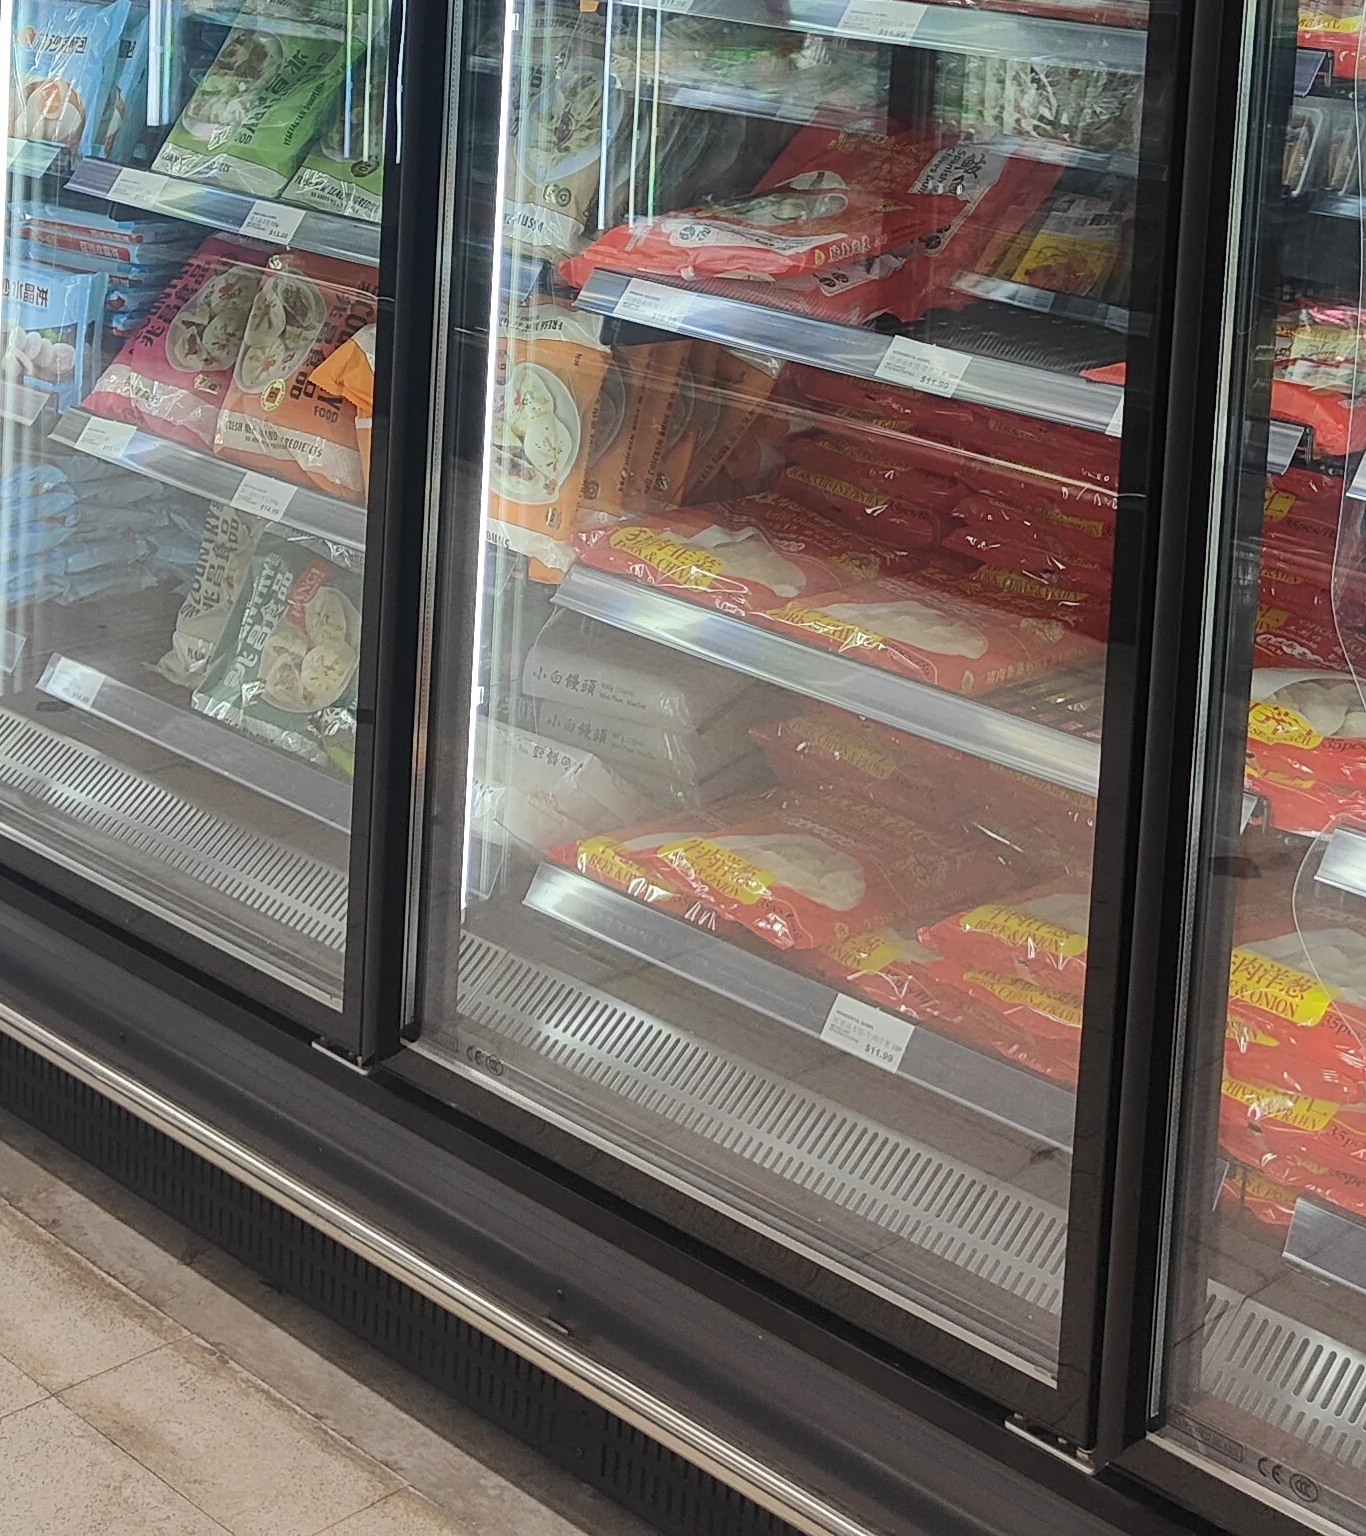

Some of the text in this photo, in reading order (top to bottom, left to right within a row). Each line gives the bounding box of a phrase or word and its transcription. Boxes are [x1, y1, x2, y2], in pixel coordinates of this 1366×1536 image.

[313, 404, 339, 423] FOOD
[1249, 990, 1300, 1020] ONION
[864, 1043, 894, 1063] $11.99
